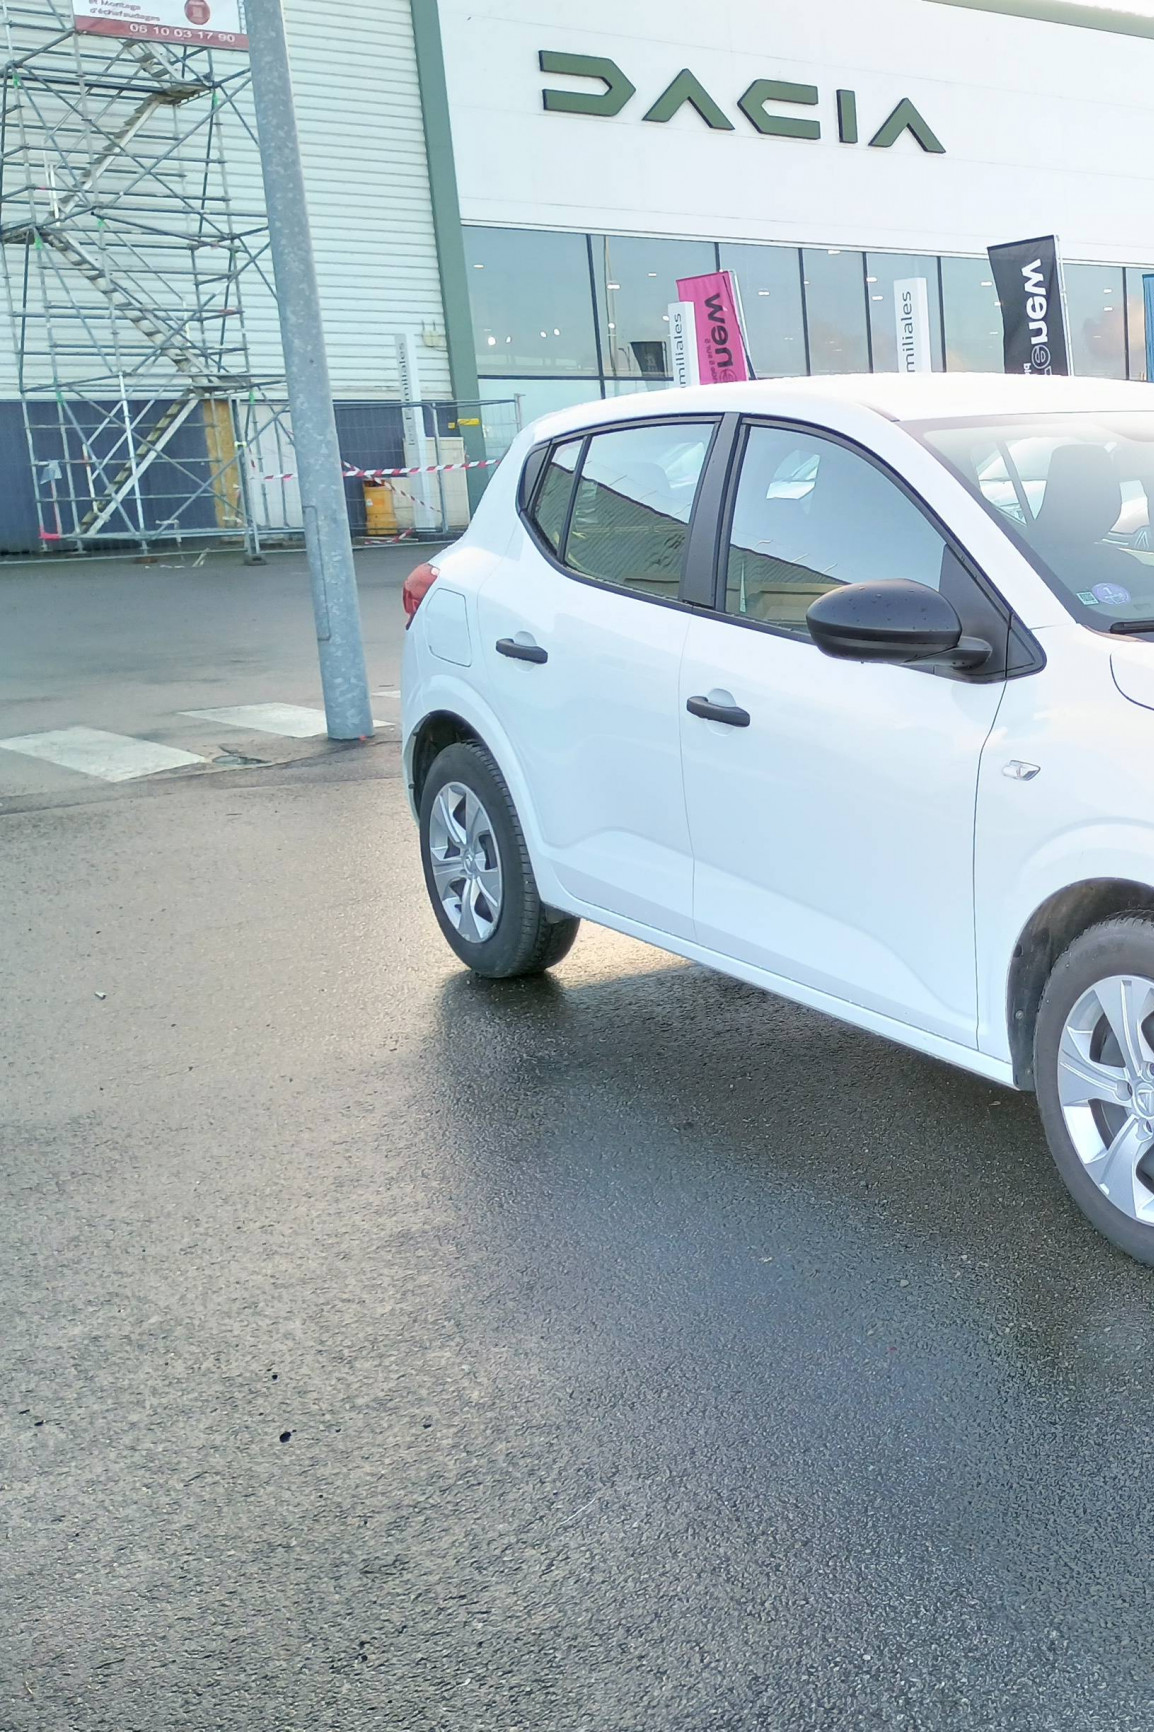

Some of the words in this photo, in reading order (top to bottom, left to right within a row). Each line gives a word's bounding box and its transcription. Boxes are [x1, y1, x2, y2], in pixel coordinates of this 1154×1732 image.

[153, 26, 170, 36] 10
[173, 28, 192, 38] 03
[198, 31, 214, 40] 17
[218, 33, 235, 43] 90
[538, 50, 946, 154] DACIA
[674, 313, 687, 386] miliales
[900, 291, 915, 373] miliales
